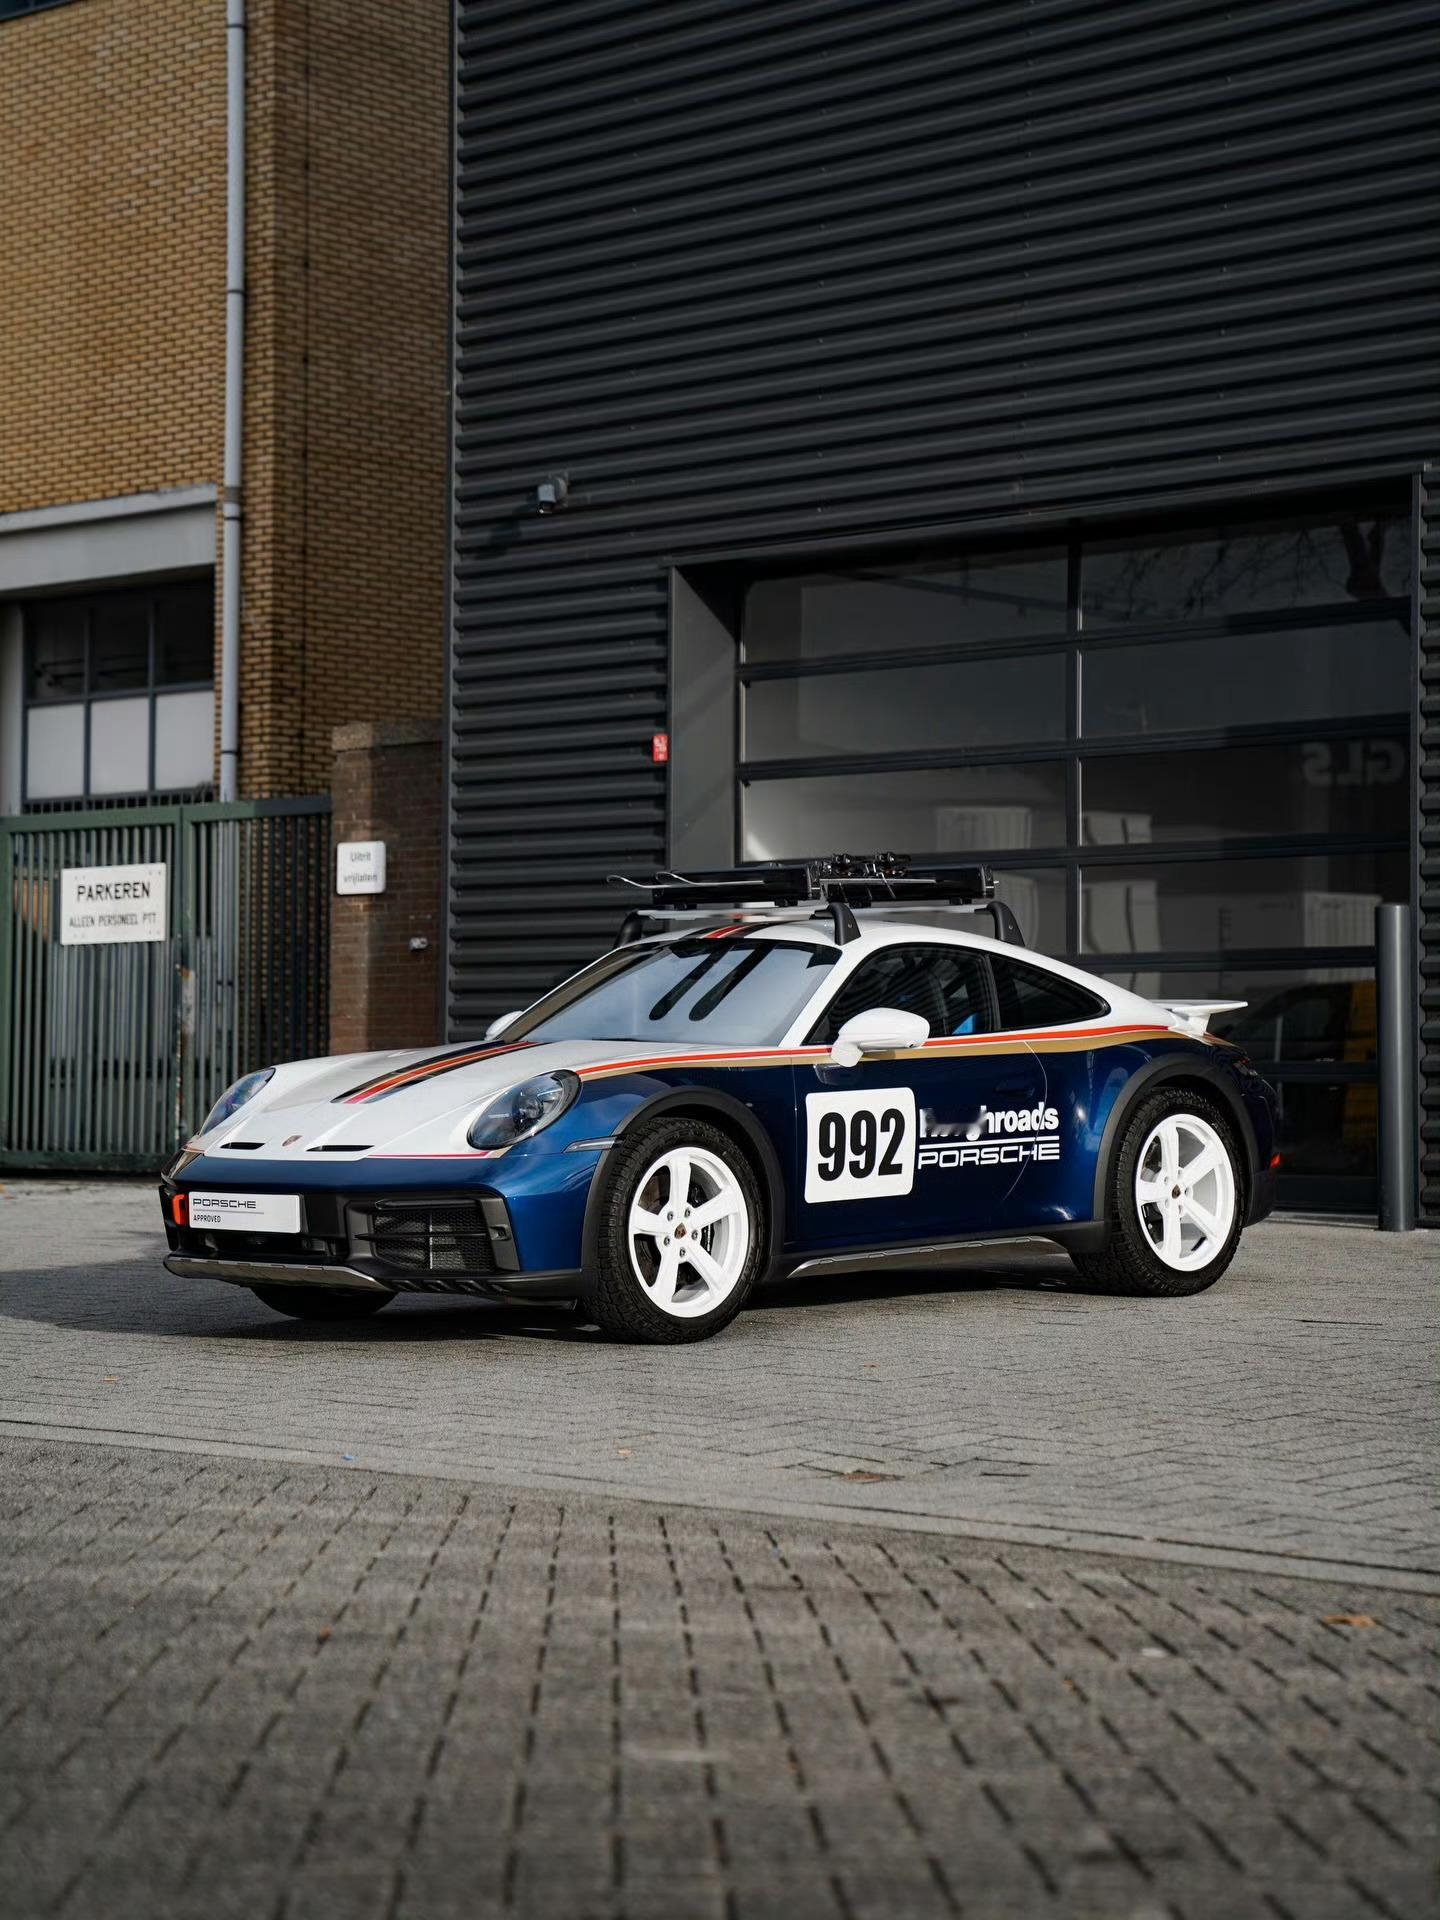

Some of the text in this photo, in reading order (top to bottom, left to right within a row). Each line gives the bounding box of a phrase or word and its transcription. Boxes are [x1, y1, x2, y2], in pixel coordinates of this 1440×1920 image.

[77, 881, 150, 902] PARKEREN
[69, 911, 157, 928] ALLEEN PERSONEEL PTT
[817, 1107, 906, 1182] 992
[917, 1143, 1060, 1170] PORSCHE
[193, 1198, 257, 1209] PORSCHE
[193, 1214, 221, 1223] APPROVED
